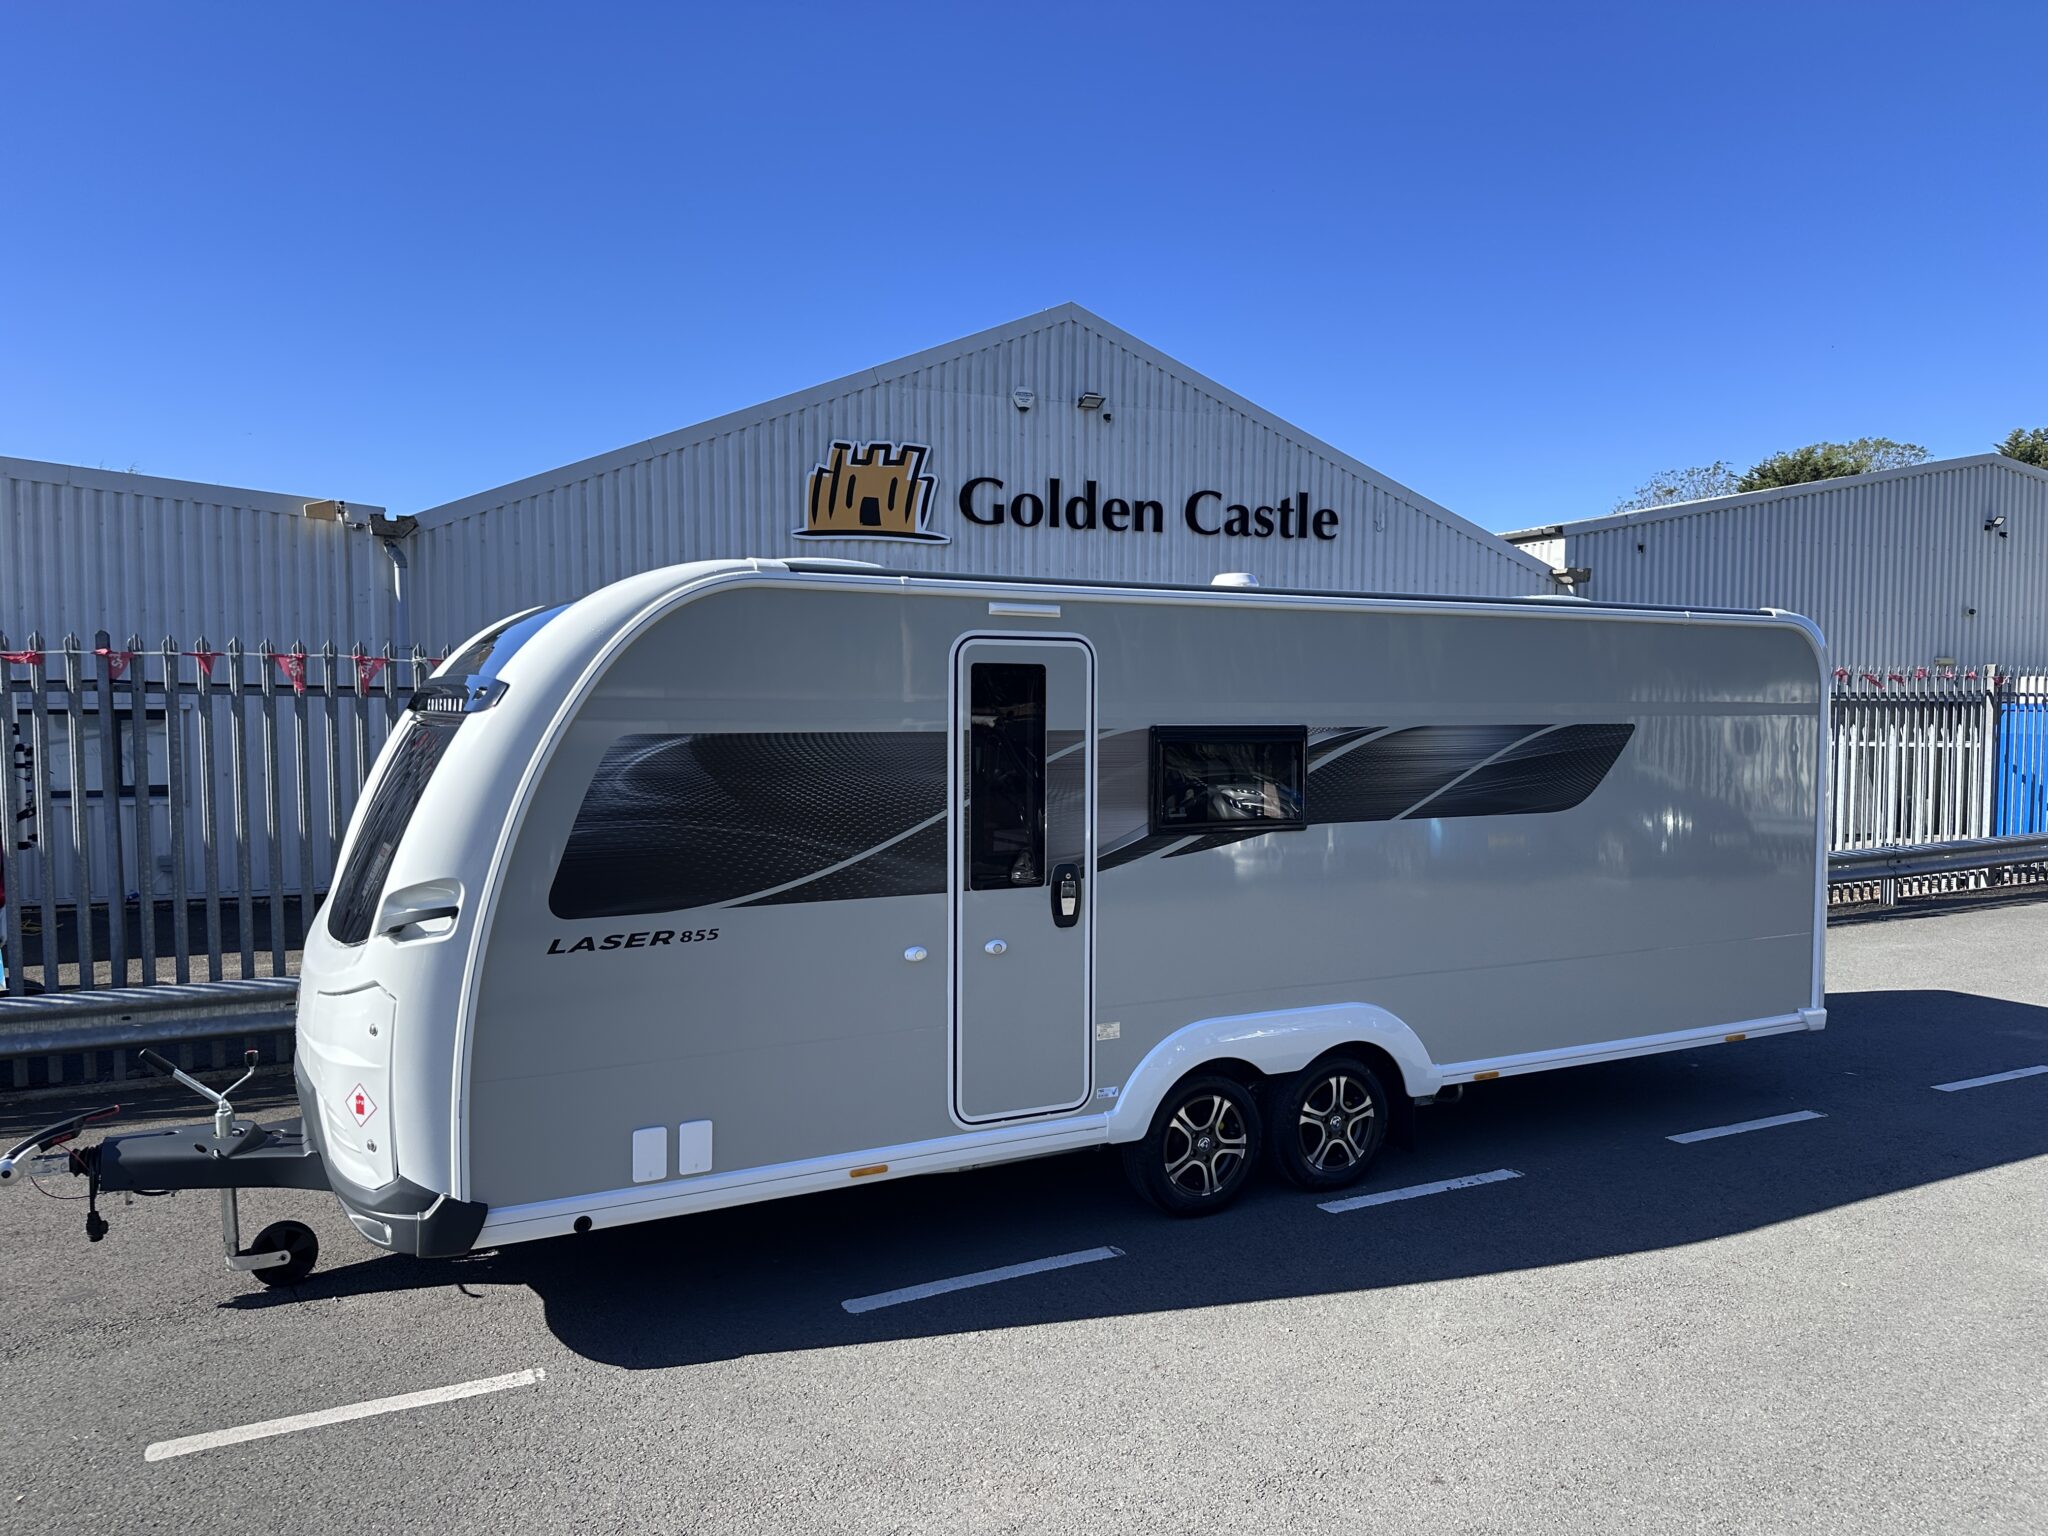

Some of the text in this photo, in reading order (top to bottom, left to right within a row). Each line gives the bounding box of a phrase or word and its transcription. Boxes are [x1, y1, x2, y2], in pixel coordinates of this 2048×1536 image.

[958, 476, 1340, 541] Golden Castle
[427, 698, 463, 712] COACHMAN
[546, 928, 720, 955] LASER 855
